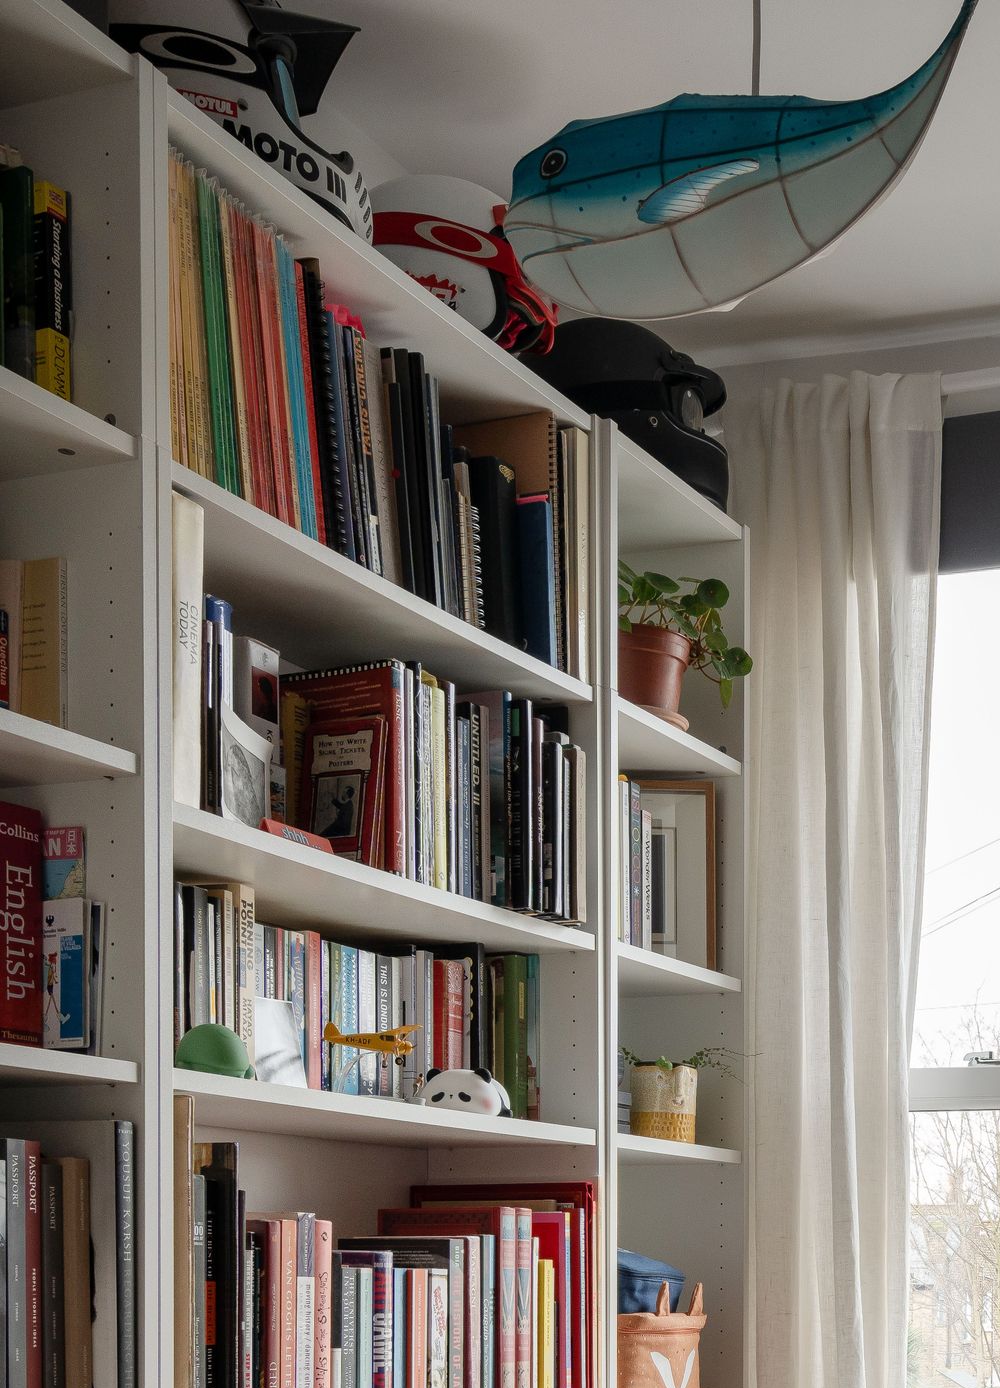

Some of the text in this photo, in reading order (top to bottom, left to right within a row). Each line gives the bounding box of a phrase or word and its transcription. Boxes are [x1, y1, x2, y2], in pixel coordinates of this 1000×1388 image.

[223, 119, 320, 182] MOTO
[51, 219, 64, 331] Starting a Business
[179, 600, 189, 649] TODAY
[190, 604, 199, 665] CINEMA
[0, 821, 39, 843] Collins
[66, 830, 78, 856] 日本
[0, 860, 35, 1000] English
[380, 964, 388, 1034] THIS IS LONDO
[1, 1030, 39, 1043] Thesaurus
[29, 1155, 37, 1214] PASSPORT
[122, 1141, 131, 1202] YOUSUF
[123, 1209, 131, 1262] KARSH
[207, 1265, 214, 1279] OF
[343, 1275, 349, 1285] IN
[123, 1269, 133, 1362] REGARDING
[453, 1300, 461, 1353] HISTORY
[269, 1361, 278, 1388] RED
[304, 1344, 312, 1371] dancing
[453, 1355, 461, 1369] OF
